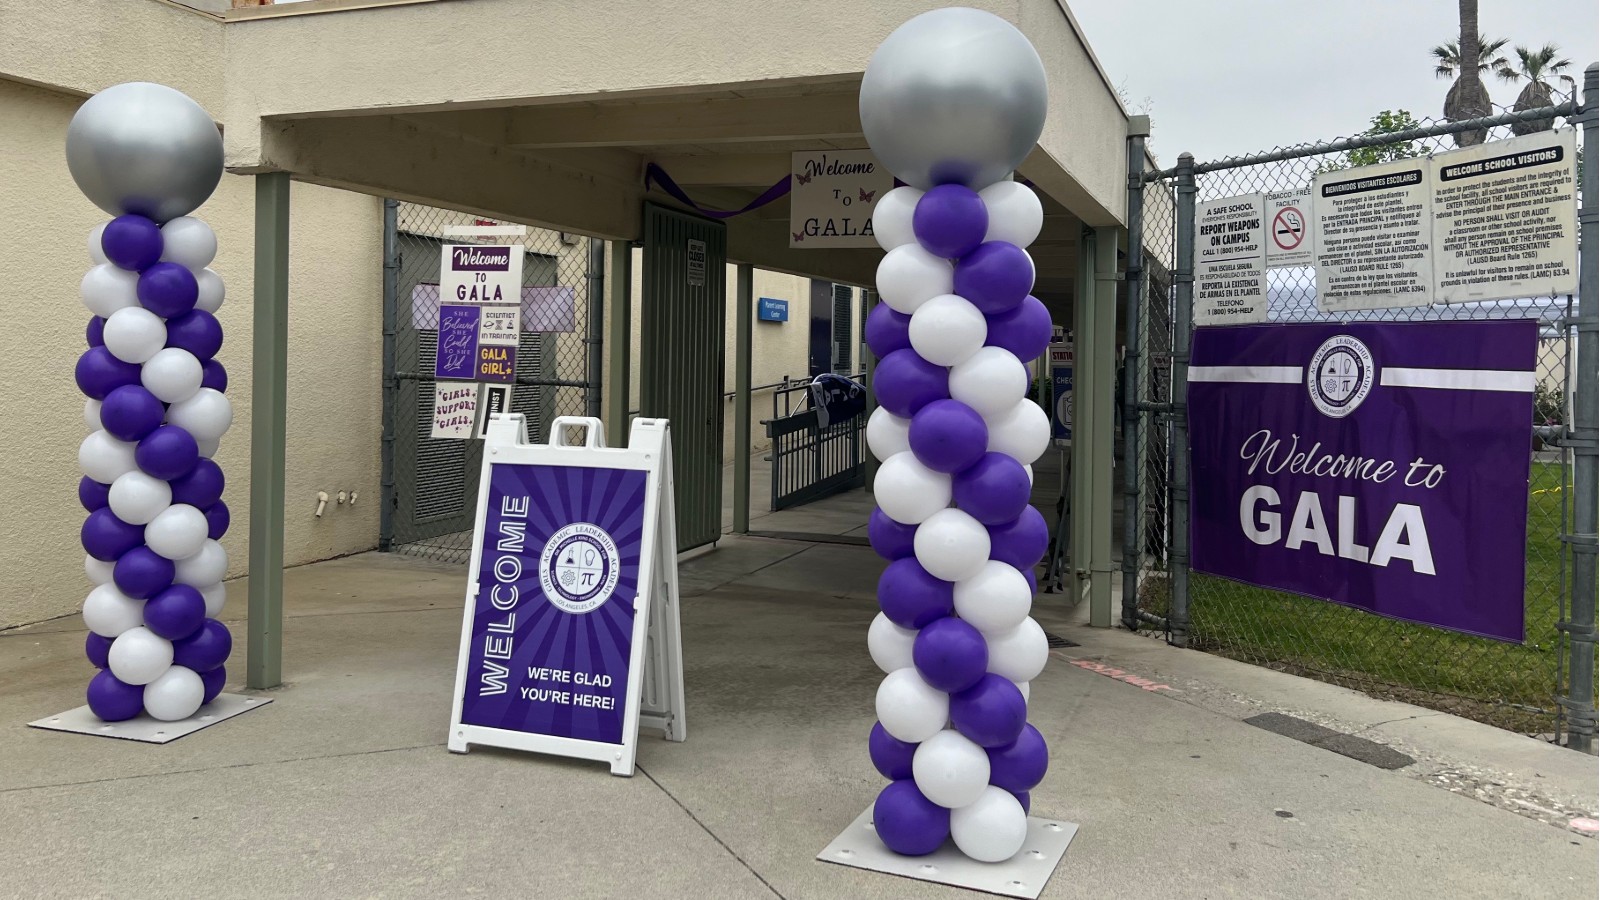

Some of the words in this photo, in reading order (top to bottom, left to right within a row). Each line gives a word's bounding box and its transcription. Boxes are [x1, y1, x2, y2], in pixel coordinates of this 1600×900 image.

[805, 154, 875, 177] Welcome
[1446, 163, 1483, 177] WELCOME
[1485, 157, 1516, 170] SCHOOL
[1518, 150, 1557, 164] VISITORS
[1325, 182, 1357, 194] BIENVENIDOS
[1358, 178, 1386, 189] VISITANTES
[1387, 173, 1417, 185] ESCOLARES
[1442, 187, 1455, 195] order
[1463, 182, 1481, 192] protect
[1492, 178, 1515, 186] students
[1538, 170, 1562, 179] integrity
[832, 189, 852, 206] TO
[1265, 192, 1292, 201] TOBACCO
[1296, 188, 1312, 197] FREE
[1276, 199, 1300, 207] FACILITY
[1344, 196, 1363, 205] proteger
[1377, 191, 1405, 200] estudiantes
[1446, 201, 1463, 210] ENTER
[1464, 197, 1491, 206] THROUGH
[1492, 195, 1503, 203] THE
[1504, 192, 1519, 200] MAIN
[1521, 187, 1552, 198] ENTRANCE
[1213, 206, 1227, 215] SAFE
[1228, 202, 1253, 213] SCHOOL
[1226, 210, 1257, 220] RESPONSIBILITY
[1463, 217, 1485, 226] PERSON
[1486, 214, 1504, 222] SHALL
[1505, 211, 1520, 220] VISIT
[1522, 210, 1530, 218] OR
[1531, 207, 1549, 216] AUDIT
[804, 218, 875, 237] GALA
[1200, 223, 1226, 236] REPORT
[1227, 218, 1260, 232] WEAPONS
[1454, 226, 1480, 235] classroom
[1504, 220, 1522, 228] school
[1523, 217, 1545, 225] activity,
[1468, 233, 1486, 242] person
[1488, 230, 1506, 238] remain
[1516, 226, 1534, 234] school
[1536, 223, 1562, 233] premises
[1210, 235, 1221, 247] ON
[1222, 232, 1250, 245] CAMPUS
[1443, 242, 1467, 251] WITHOUT
[1480, 237, 1510, 247] APPROVAL
[1533, 231, 1564, 241] PRINCIPAL
[454, 247, 508, 266] Welcome
[1220, 246, 1233, 255] (800)
[1234, 244, 1258, 253] 954-HELP
[1465, 246, 1499, 257] AUTHORIZED
[1501, 241, 1550, 252] REPRESENTATIVE
[1467, 256, 1488, 266] (LAUSD
[1490, 254, 1506, 262] Board
[1522, 251, 1538, 259] 1265)
[475, 273, 486, 283] TO
[1201, 281, 1223, 290] REPORTA
[1231, 279, 1258, 288] EXISTENCIA
[1205, 272, 1240, 280] RESPONSABILIDAD
[456, 284, 503, 301] GALA
[1207, 290, 1225, 298] ARMAS
[1226, 289, 1232, 297] EN
[1240, 288, 1261, 296] PLANTEL
[1227, 307, 1254, 315] 954-HELP
[441, 316, 479, 332] Believed
[443, 334, 472, 349] Could
[1336, 338, 1369, 360] LEADERSHIP
[481, 348, 508, 361] GALA
[1053, 351, 1073, 360] STATIO
[1310, 341, 1333, 375] ACADEMIC
[481, 362, 506, 375] GIRL
[1056, 376, 1073, 384] CHEC
[1357, 365, 1372, 399] ACADEMY
[442, 388, 471, 401] GIRLS
[1310, 380, 1319, 400] GIRLS
[436, 400, 476, 414] SUPPORT
[1320, 404, 1329, 412] LOS
[439, 415, 469, 428] GIRLS
[1240, 429, 1397, 483] Welcome
[1404, 457, 1447, 489] to
[1240, 484, 1437, 576] GALA
[543, 529, 571, 564] ACADEMIC
[575, 526, 614, 552] LEADERSHIP
[542, 568, 553, 593] GIRLS
[602, 557, 618, 597] ACADEMY
[479, 495, 530, 696] WELCOME
[556, 598, 565, 607] LOS
[589, 600, 597, 608] CA
[528, 666, 571, 683] WE'RE
[574, 672, 612, 688] GLAD
[520, 686, 571, 704] YOU'RE
[573, 693, 615, 710] HERE!
